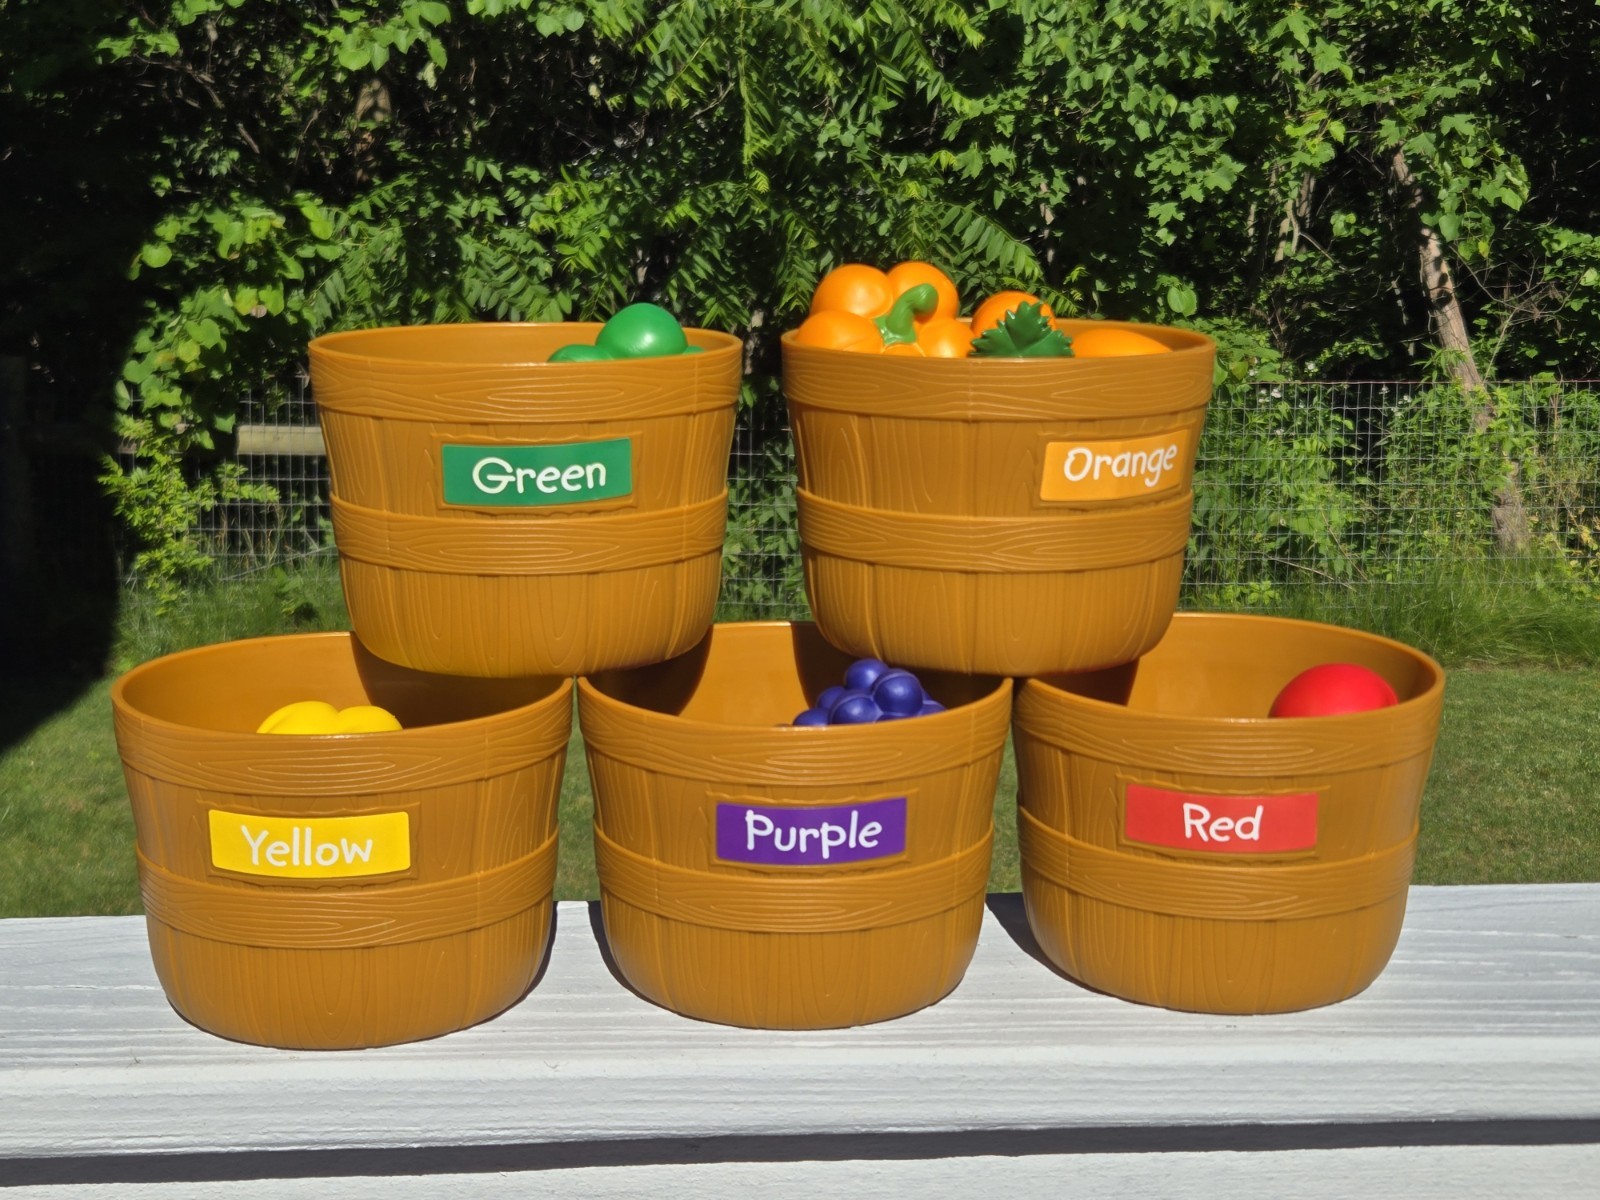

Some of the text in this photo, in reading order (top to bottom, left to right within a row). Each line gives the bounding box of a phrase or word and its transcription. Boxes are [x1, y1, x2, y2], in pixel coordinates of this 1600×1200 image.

[472, 456, 607, 495] Green
[1063, 444, 1178, 488] Orange
[744, 809, 883, 860] Purple
[1182, 802, 1264, 842] Red
[240, 824, 374, 867] Yellow
